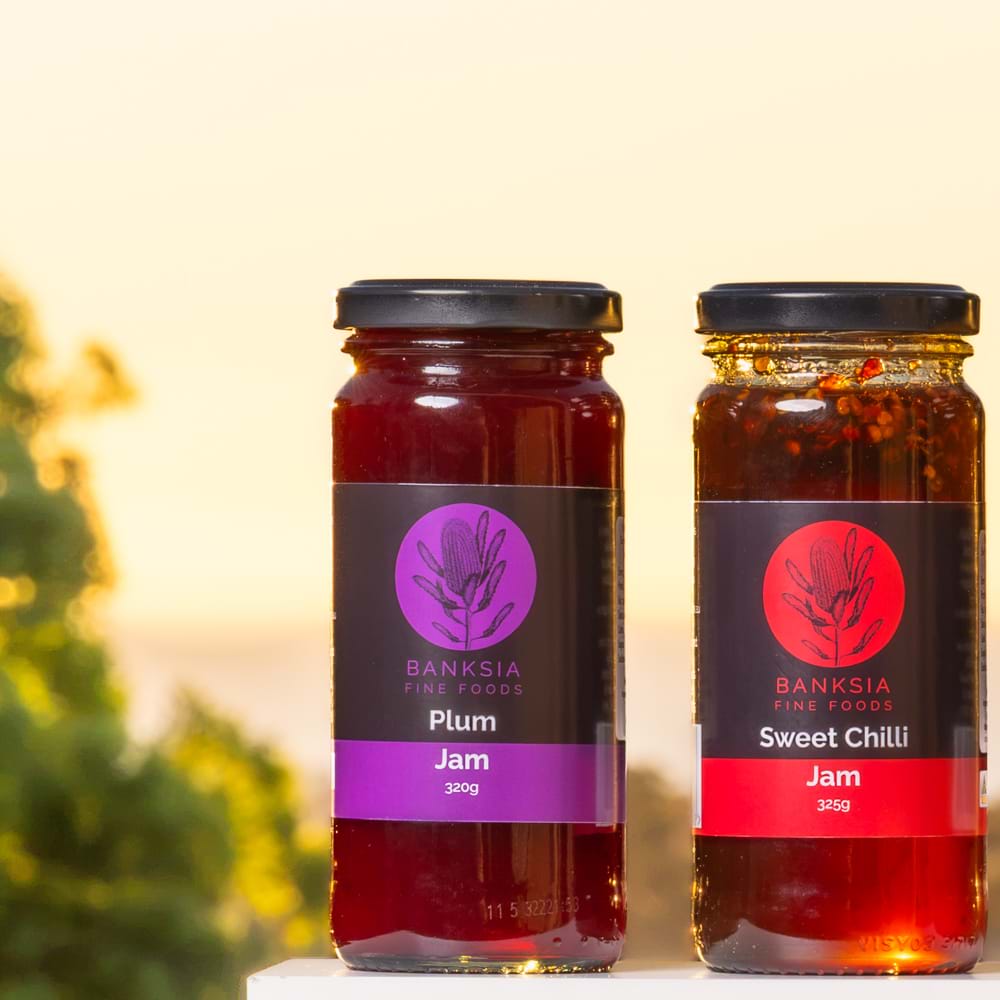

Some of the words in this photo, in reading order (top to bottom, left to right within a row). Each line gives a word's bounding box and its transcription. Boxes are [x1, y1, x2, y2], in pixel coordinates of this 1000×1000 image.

[407, 659, 520, 677] BANKSIA
[404, 682, 446, 694] FINE
[458, 683, 523, 695] FOODS
[776, 677, 890, 693] BANKSIA
[774, 700, 817, 711] FINE
[828, 699, 893, 711] FOODS
[429, 709, 497, 731] Plum
[759, 726, 839, 748] Sweet
[844, 725, 908, 747] Chilli
[434, 748, 490, 770] Jam
[806, 765, 861, 786] Jam
[444, 782, 479, 795] 320g
[817, 798, 851, 812] 325g
